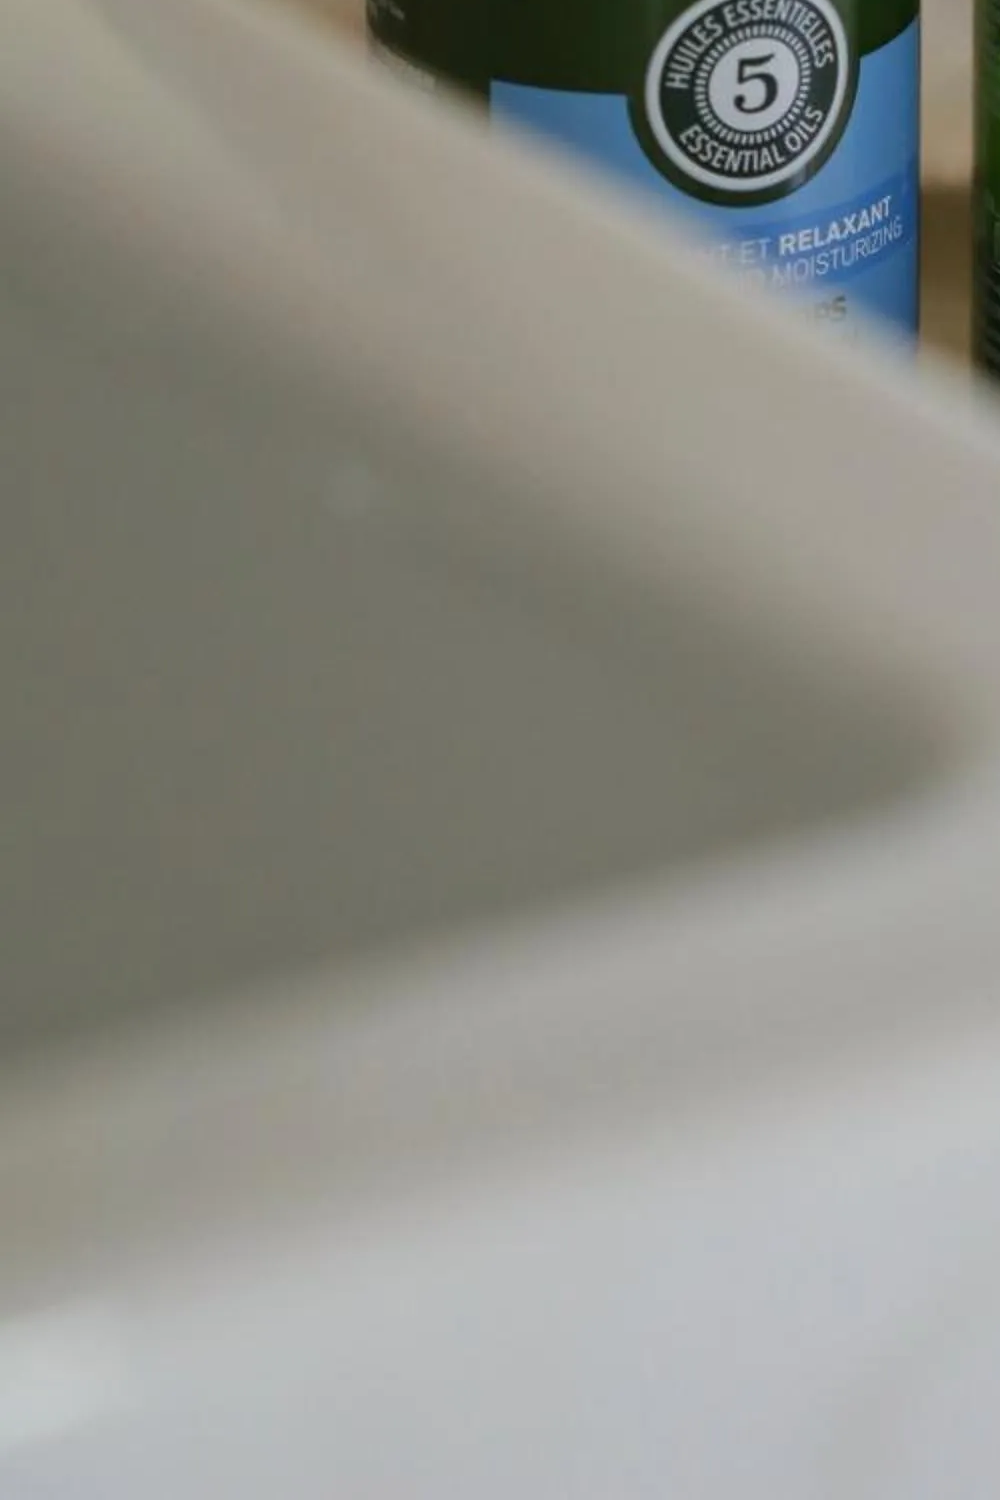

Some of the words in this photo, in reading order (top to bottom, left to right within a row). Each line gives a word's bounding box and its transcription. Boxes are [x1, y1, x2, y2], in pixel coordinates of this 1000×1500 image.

[664, 13, 725, 90] HUILES
[734, 52, 779, 115] 5
[679, 124, 787, 173] ESSENTIAL
[784, 105, 824, 152] OILS
[778, 195, 893, 257] RELAXANT
